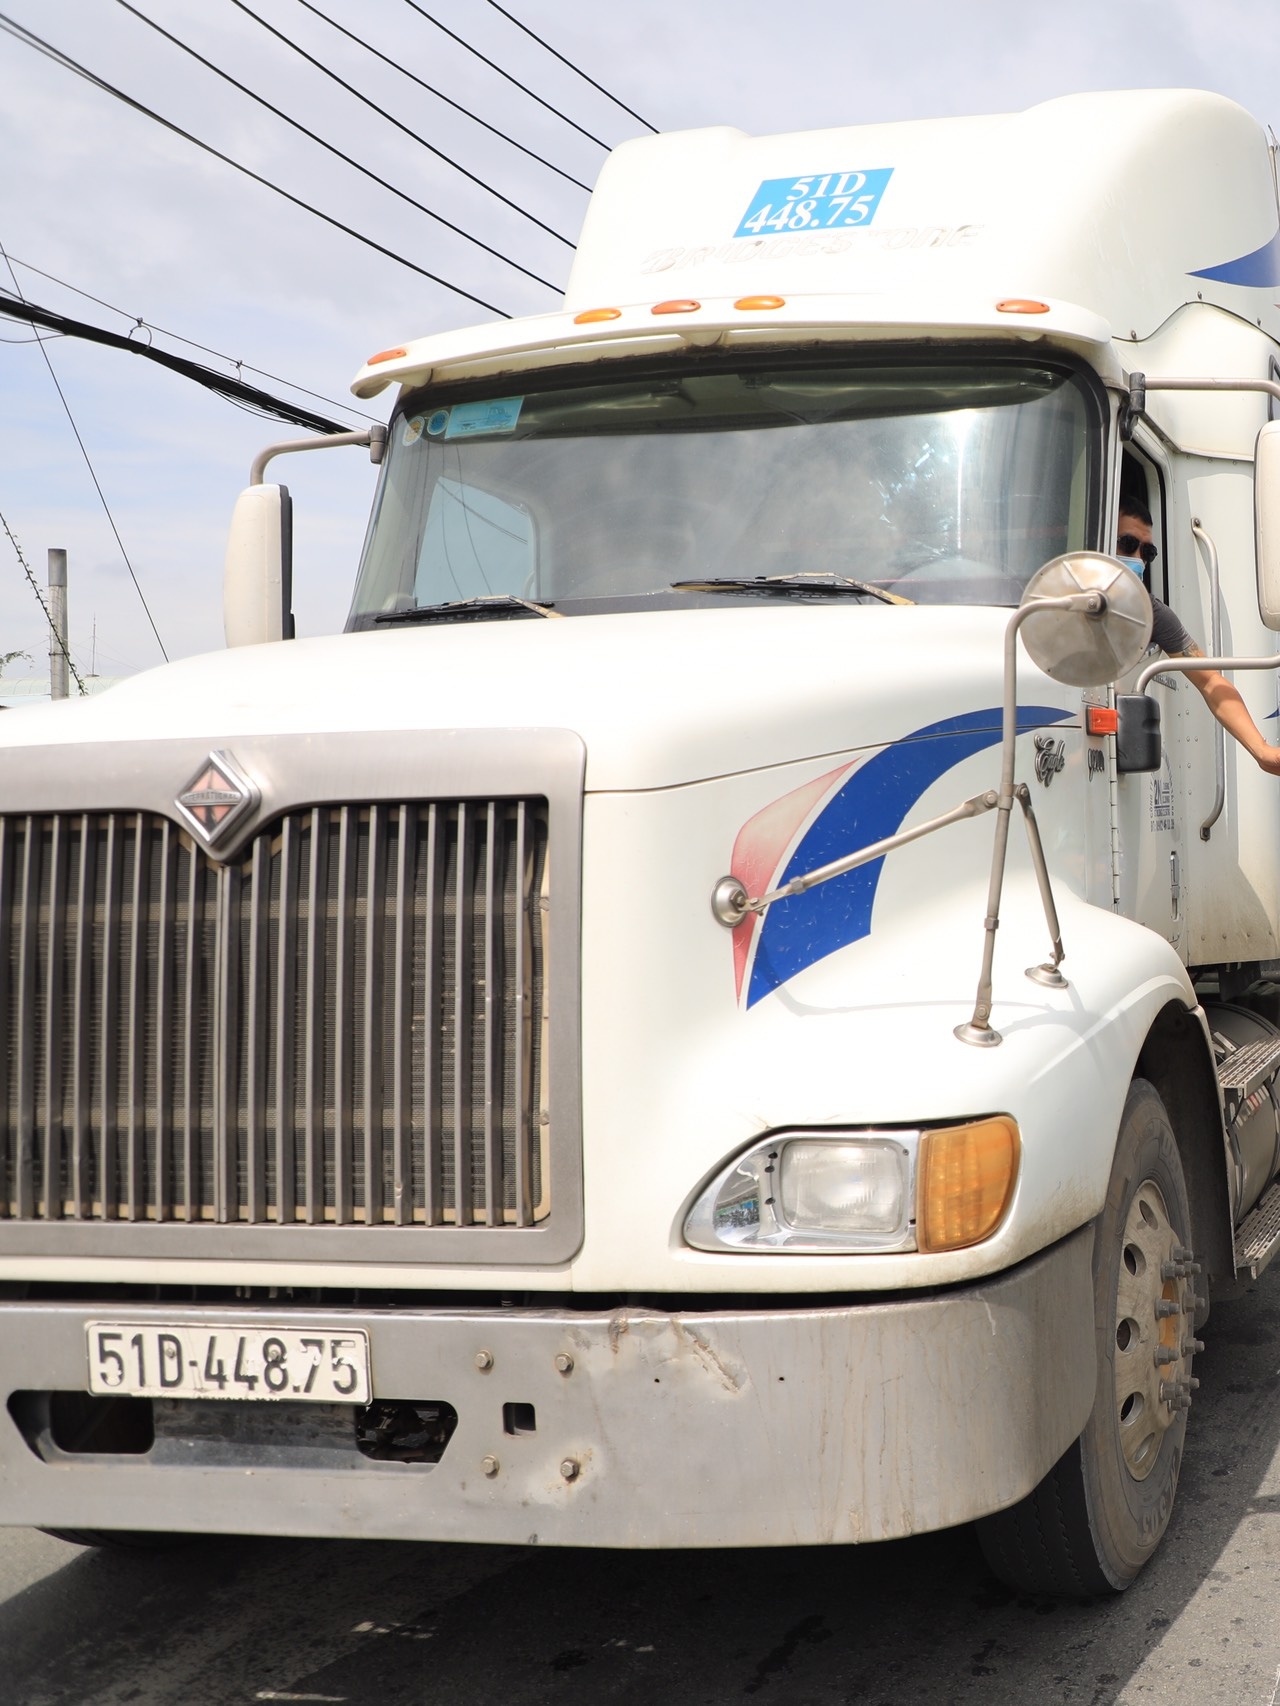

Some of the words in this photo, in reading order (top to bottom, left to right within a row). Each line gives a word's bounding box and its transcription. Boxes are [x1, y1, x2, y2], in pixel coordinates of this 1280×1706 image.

[788, 173, 867, 201] 51D
[744, 195, 876, 234] 448.75
[97, 1332, 359, 1395] 51D-448.75
